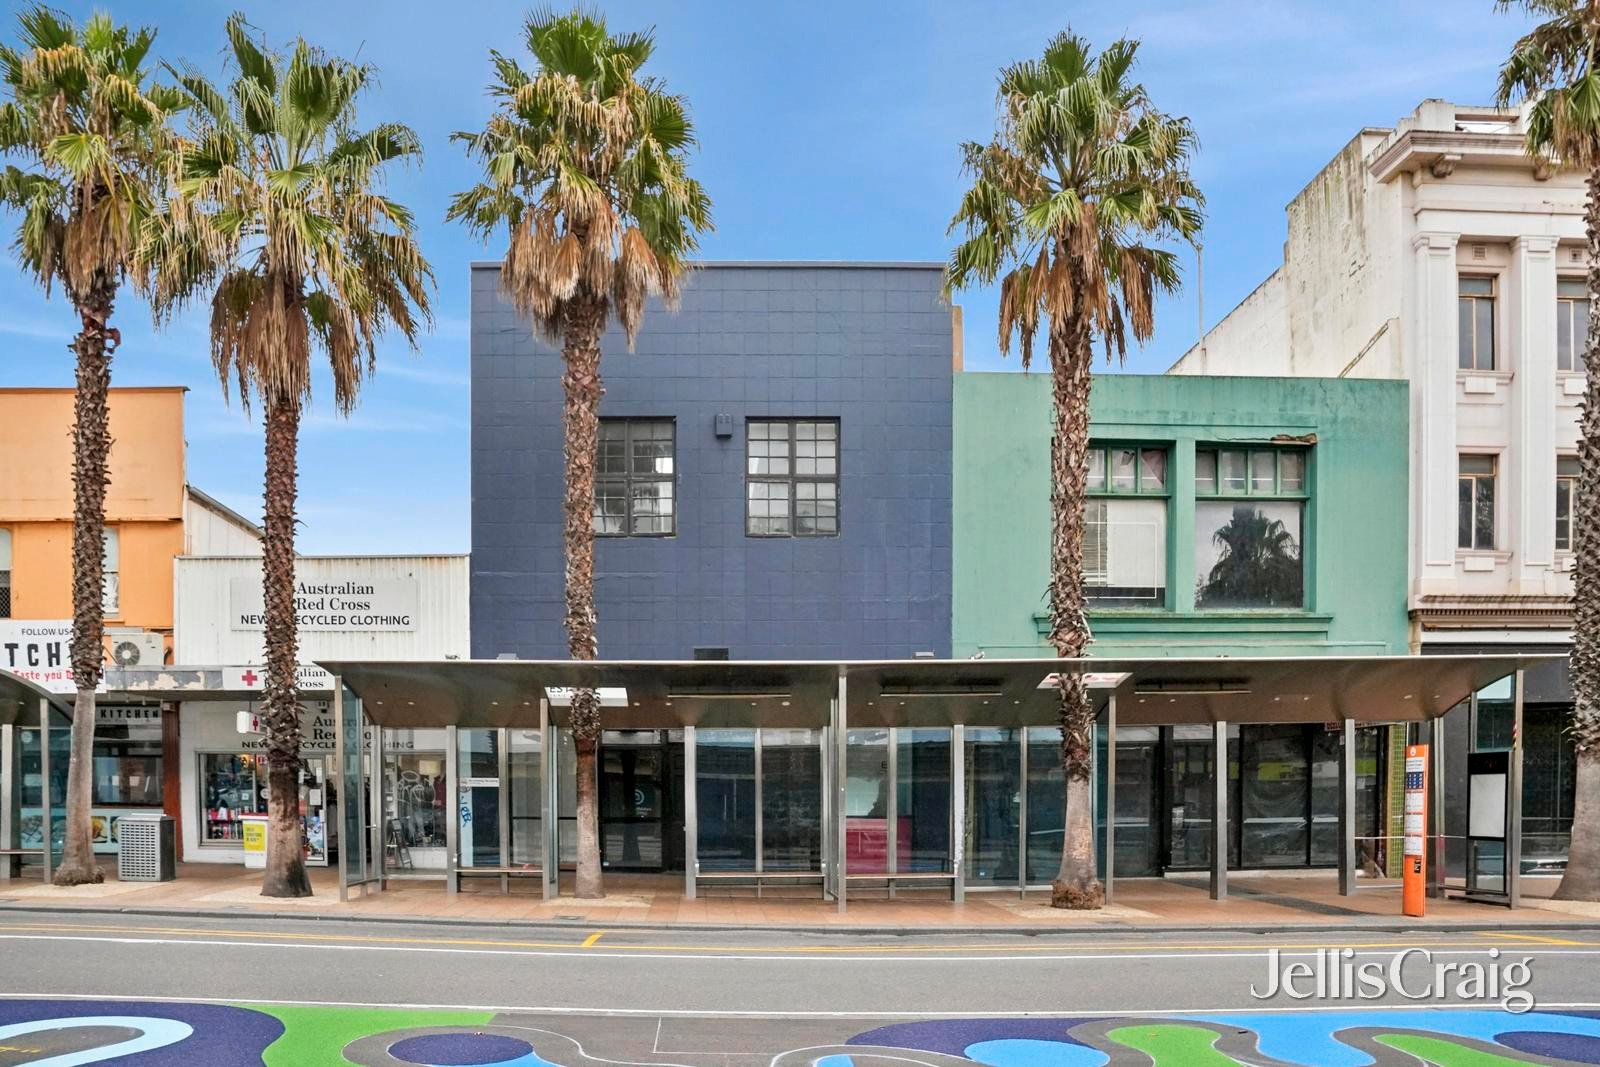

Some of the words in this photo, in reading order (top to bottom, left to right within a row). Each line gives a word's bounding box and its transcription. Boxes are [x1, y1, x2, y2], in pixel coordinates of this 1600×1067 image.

[297, 582, 375, 595] Australian
[297, 598, 325, 611] Red
[329, 598, 371, 611] Cross
[295, 615, 347, 625] ECYCLED
[350, 615, 410, 626] CLOTHING
[21, 628, 56, 636] FOLLOW
[4, 642, 61, 668] TCH
[296, 668, 327, 678] alian
[100, 709, 159, 719] KITCHEN
